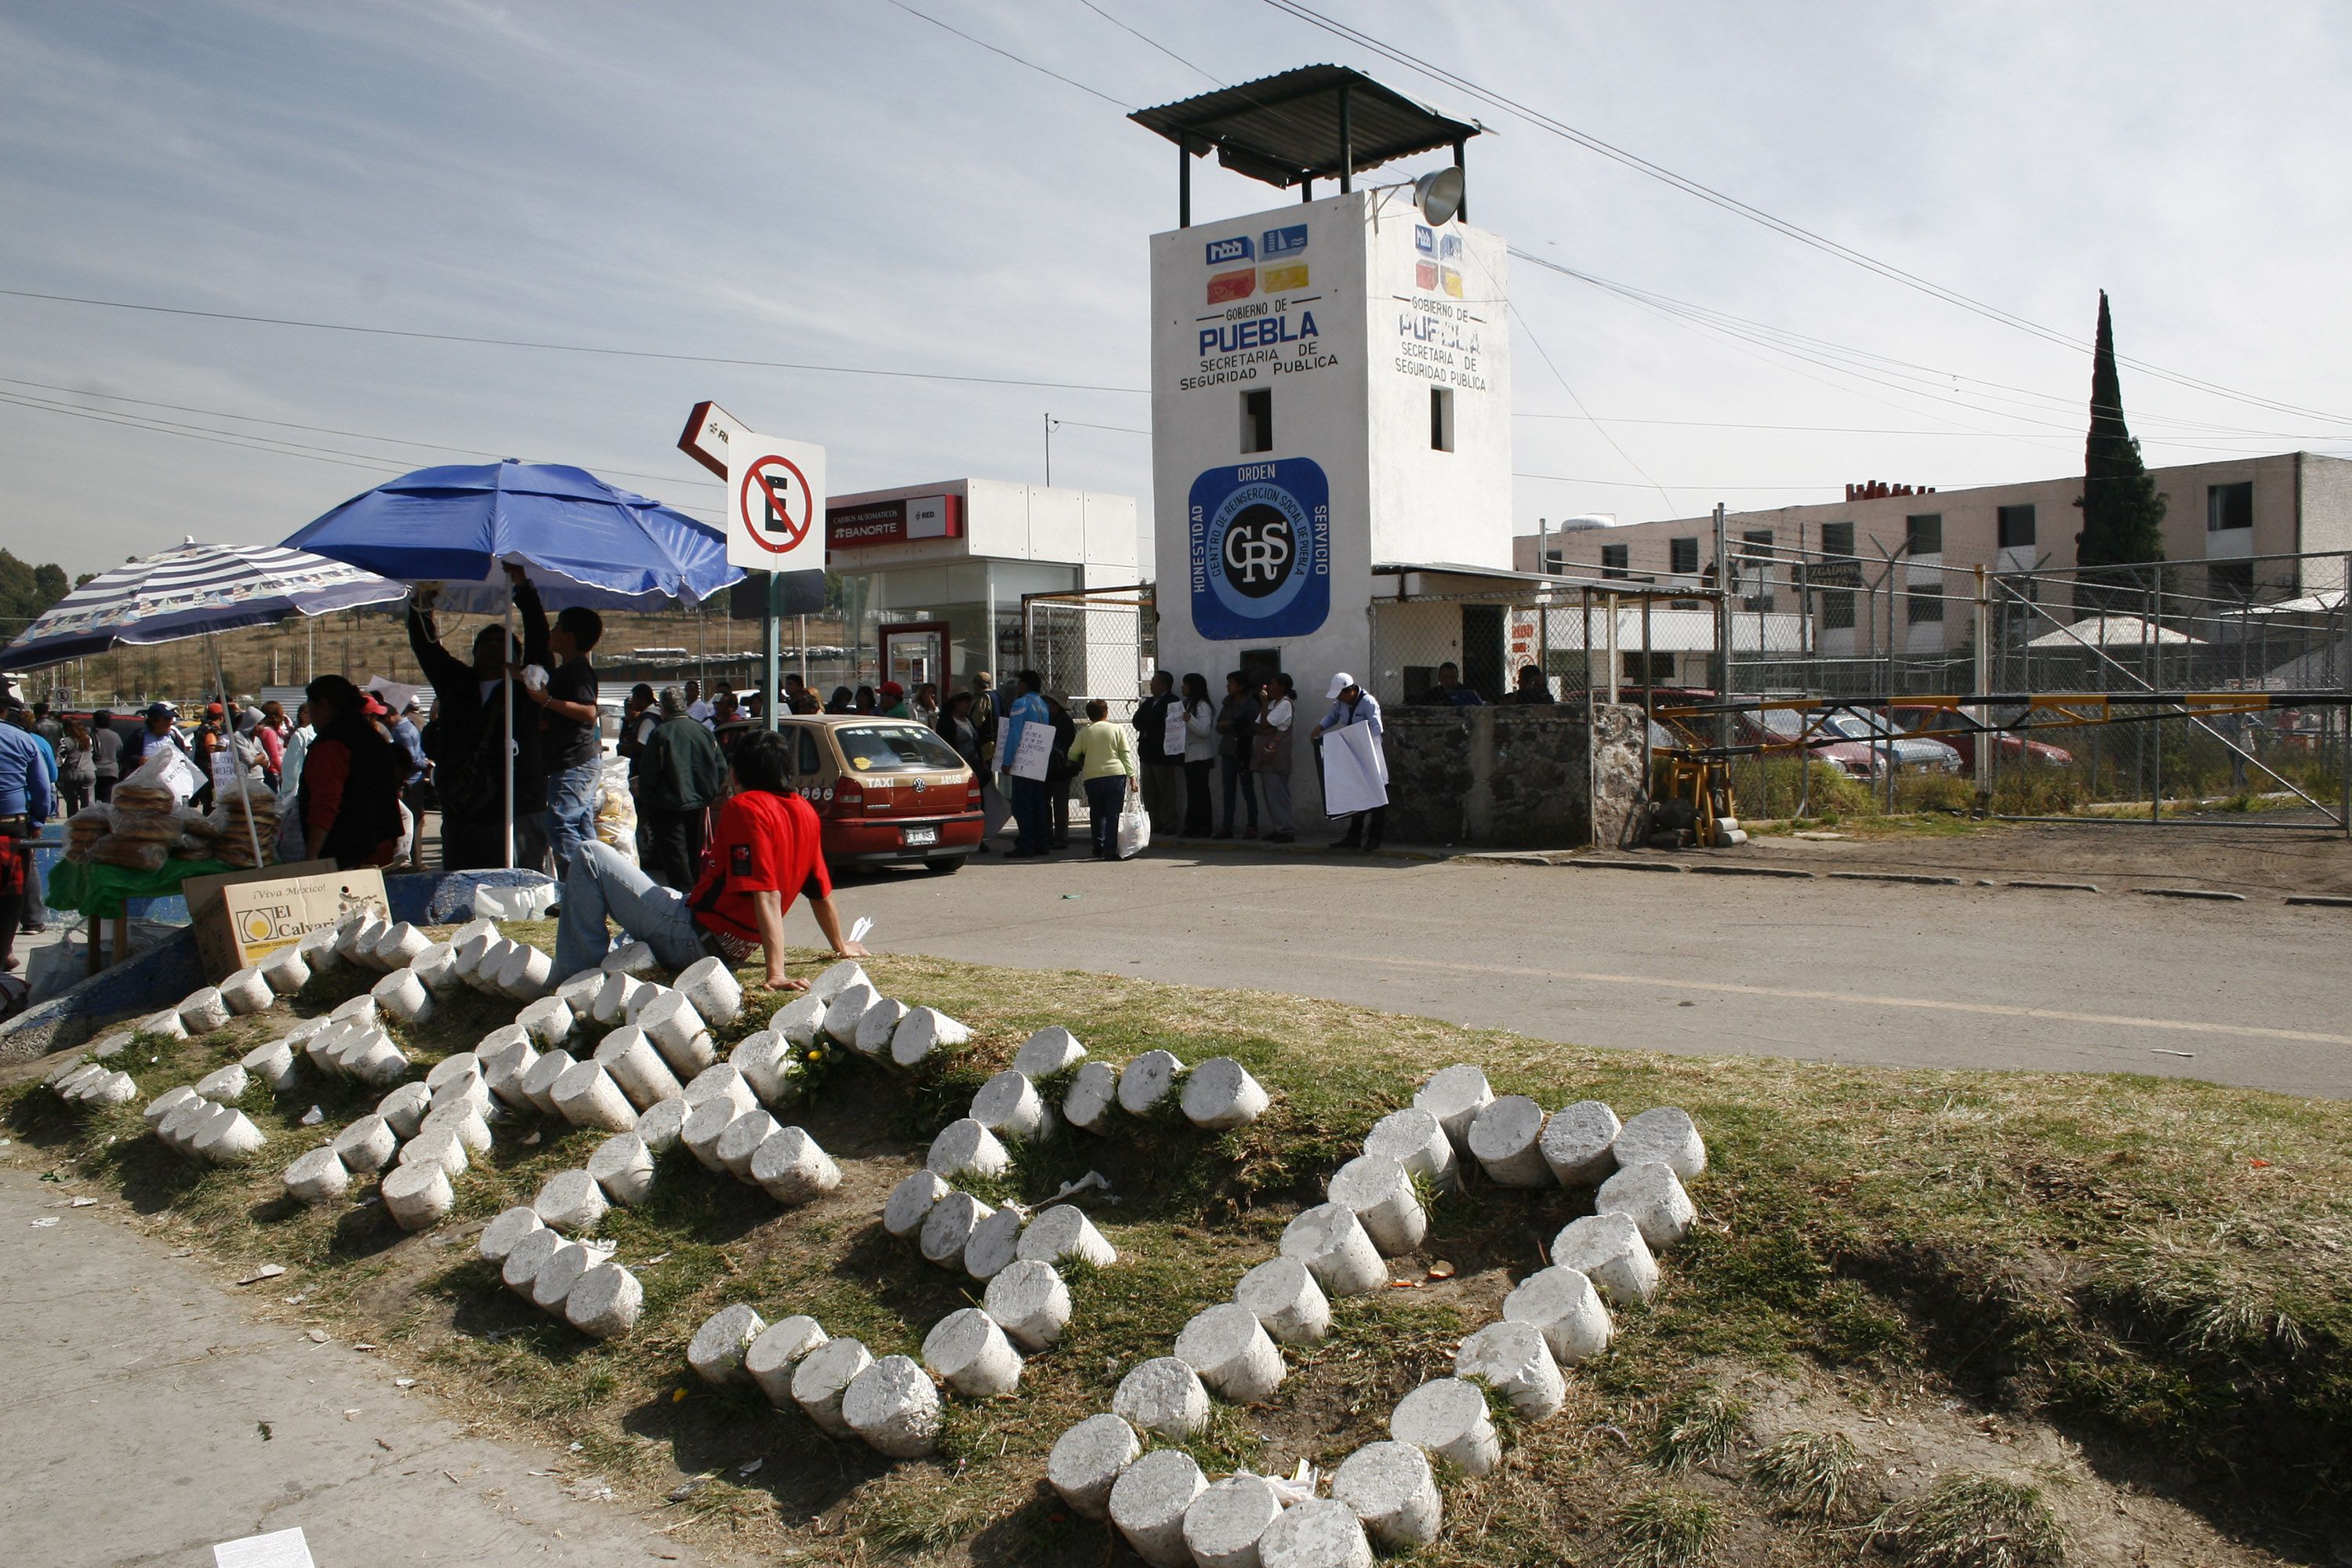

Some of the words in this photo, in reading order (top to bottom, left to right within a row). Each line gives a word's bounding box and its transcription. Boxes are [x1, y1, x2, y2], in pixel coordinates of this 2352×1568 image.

[1226, 302, 1268, 321] GOBIERNO
[1275, 298, 1287, 312] DE
[1412, 296, 1453, 318] GOBIERNO
[1457, 307, 1468, 323] DE
[1200, 311, 1319, 357] PUEBLA
[1200, 349, 1279, 372] SECRETARIA
[1298, 341, 1318, 357] DE
[1401, 341, 1454, 366] SECRETARIA
[1464, 356, 1476, 372] DE
[1180, 368, 1257, 390] SEGURIDAD
[1273, 354, 1338, 375] PUBLICA
[1395, 357, 1446, 383] SEGURIDAD
[1450, 370, 1486, 392] PUBLICA
[1238, 463, 1276, 482] ORDEN
[764, 474, 788, 533] E
[1225, 486, 1280, 515] REINSERCION
[1279, 495, 1303, 527] SOCIAL
[833, 514, 856, 524] CAJEROS
[845, 523, 897, 538] BANORTE
[1217, 513, 1228, 528] DE
[1297, 526, 1309, 541] DE
[1192, 505, 1205, 593] HONESTIDAD
[1211, 530, 1223, 577] CENTRO
[1314, 504, 1329, 575] SERVICIO
[1294, 539, 1311, 575] PUEBLA
[866, 777, 894, 788] TAXI
[252, 889, 281, 900] ¡Viva
[285, 884, 326, 896] México!
[274, 905, 292, 919] El
